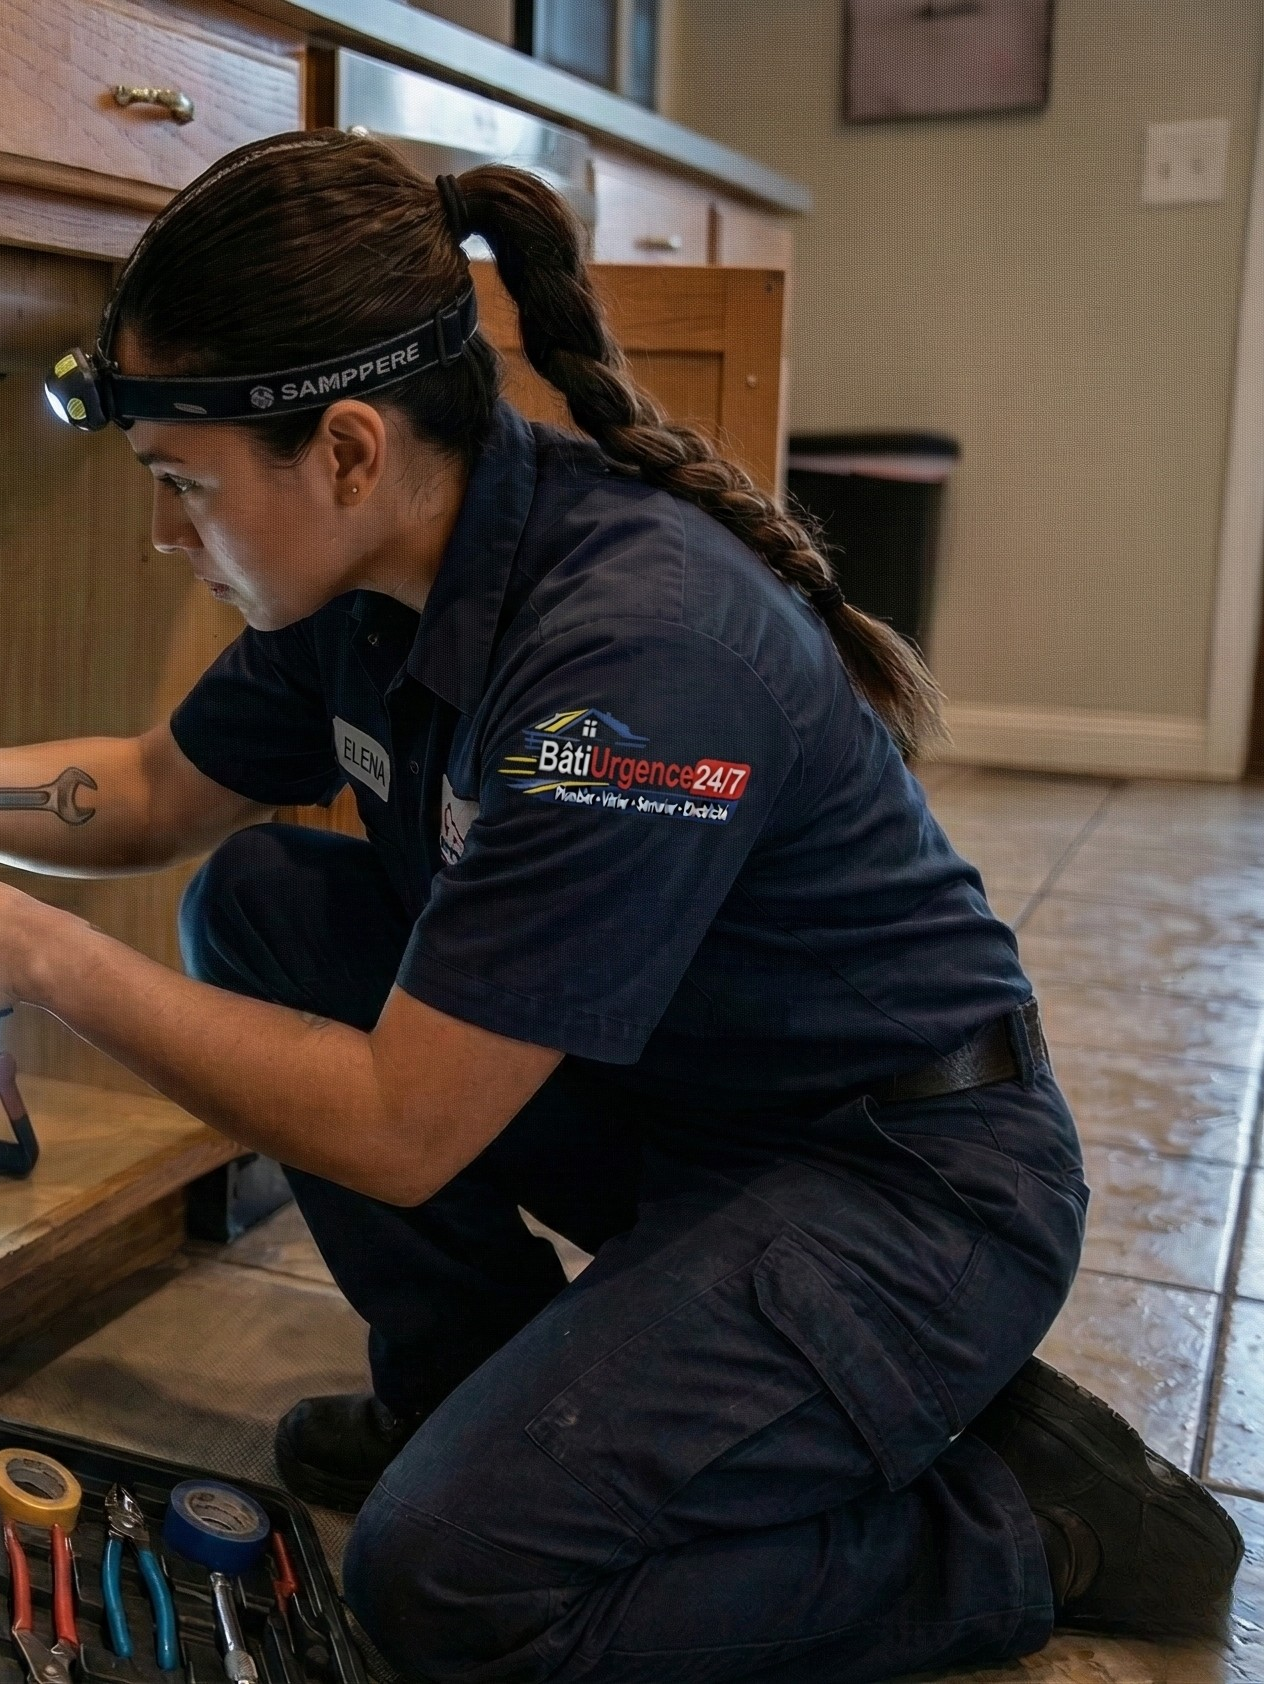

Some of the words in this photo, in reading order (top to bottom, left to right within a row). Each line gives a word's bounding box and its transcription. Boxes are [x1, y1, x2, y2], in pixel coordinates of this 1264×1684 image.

[281, 341, 420, 401] SAMPPERE
[344, 736, 386, 787] ELENA
[538, 740, 694, 790] BâtiUrgence
[692, 764, 746, 795] 24/7
